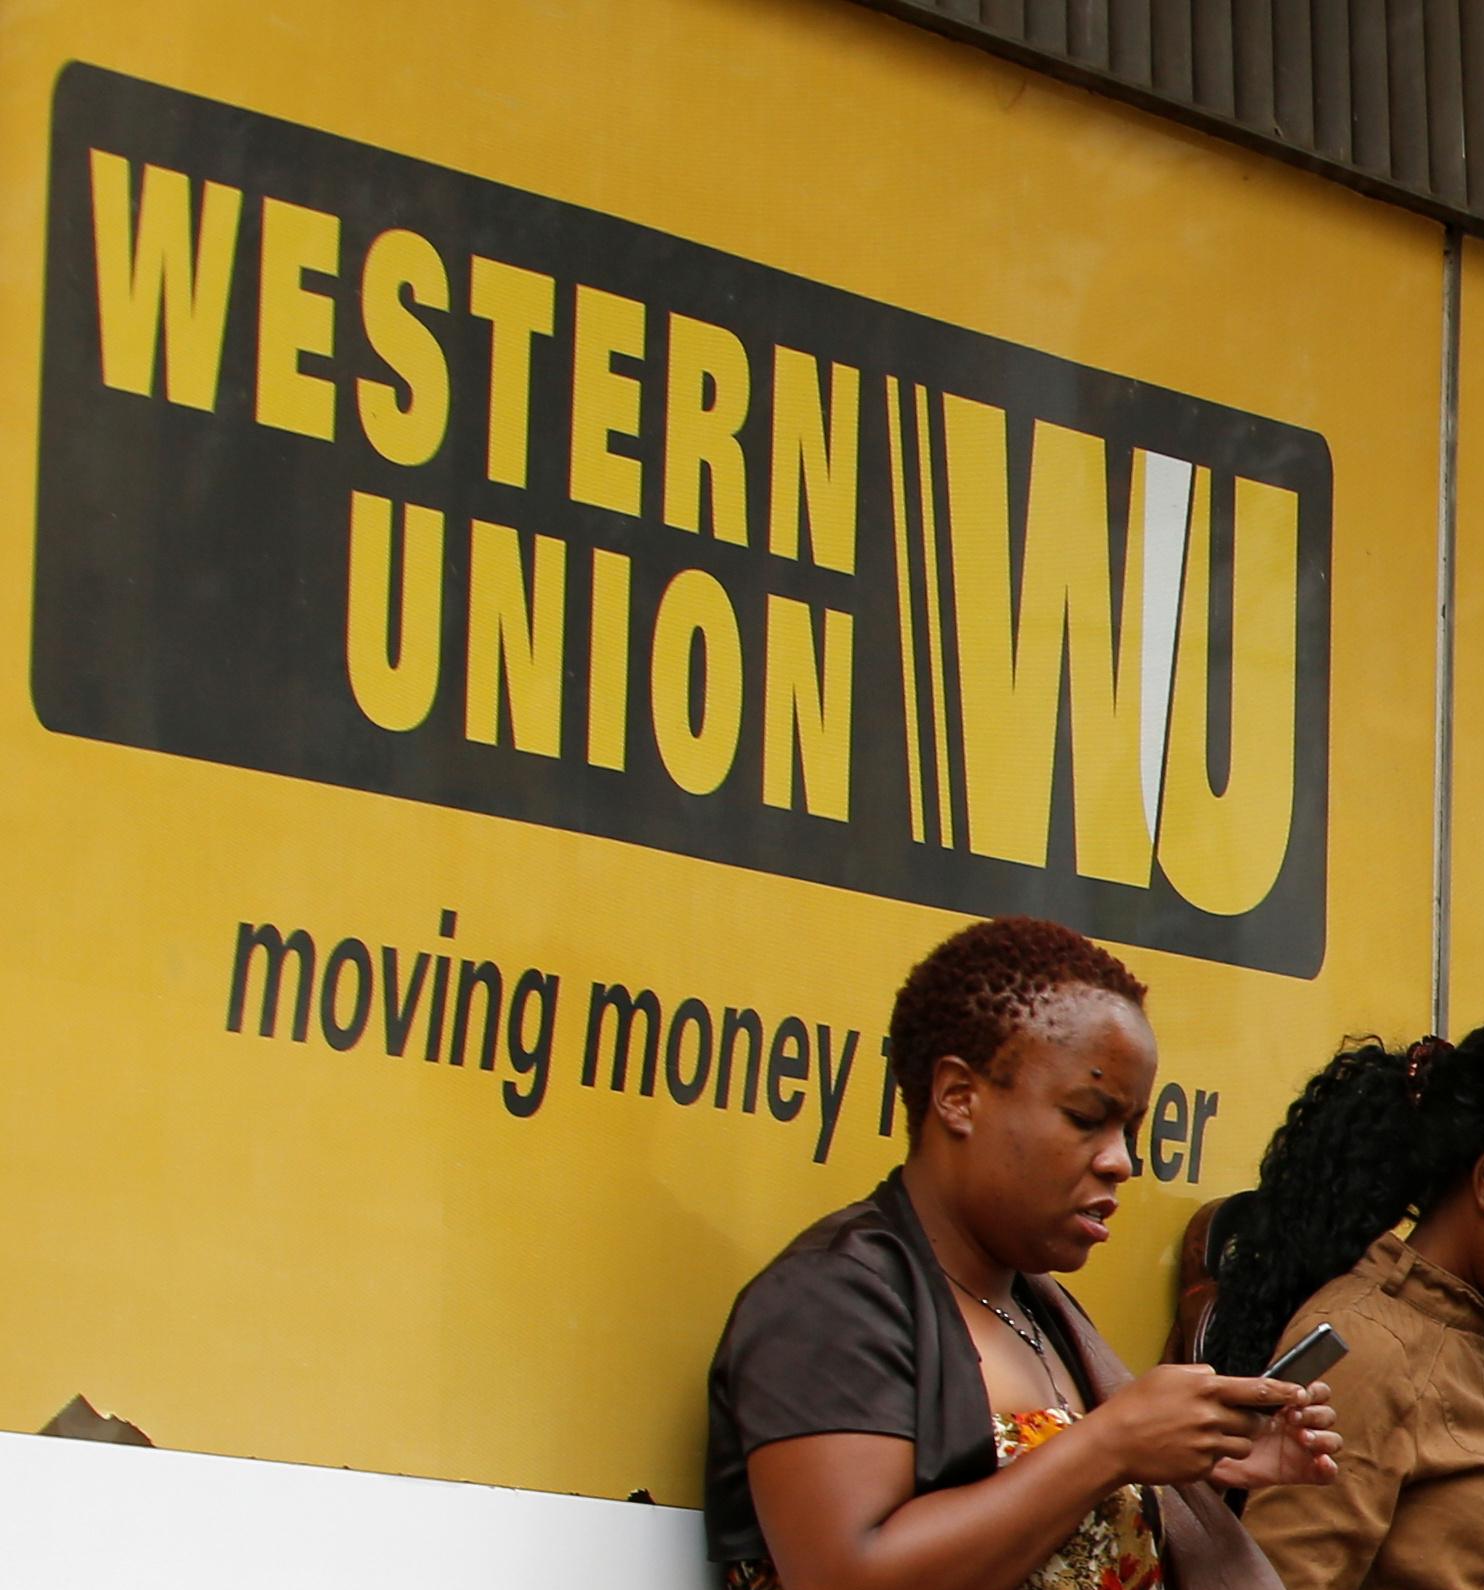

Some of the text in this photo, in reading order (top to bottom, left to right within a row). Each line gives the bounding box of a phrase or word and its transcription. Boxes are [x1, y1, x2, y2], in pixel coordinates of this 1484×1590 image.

[90, 149, 858, 575] WESTERN
[346, 489, 853, 823] UNION
[943, 391, 1299, 917] WU
[226, 907, 561, 1118] moving
[580, 980, 861, 1165] money
